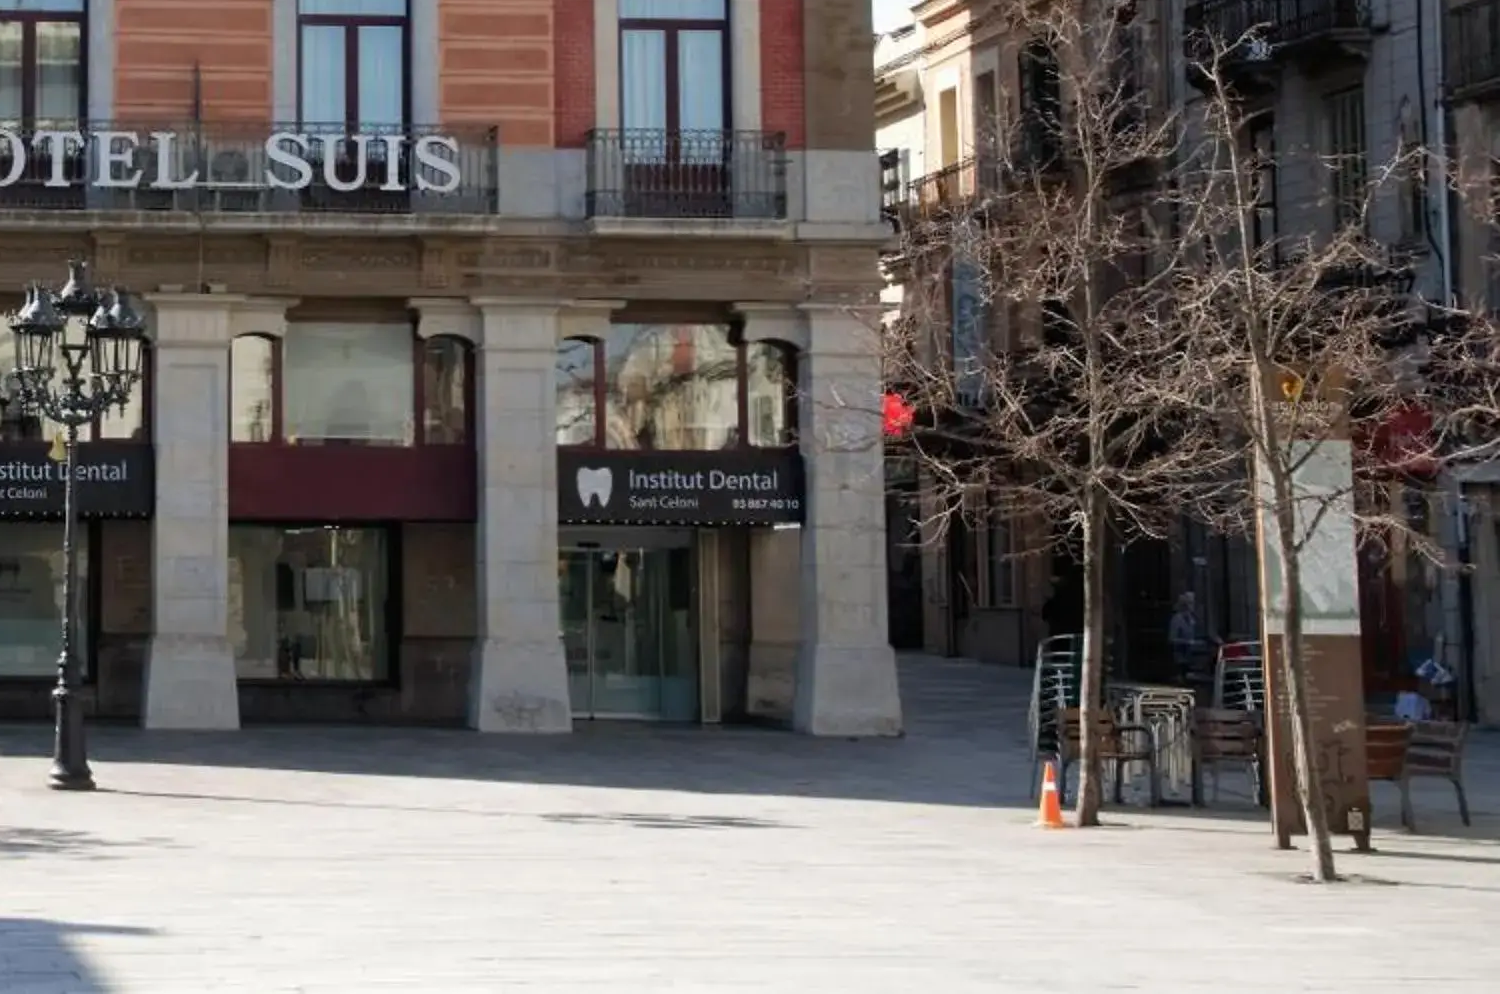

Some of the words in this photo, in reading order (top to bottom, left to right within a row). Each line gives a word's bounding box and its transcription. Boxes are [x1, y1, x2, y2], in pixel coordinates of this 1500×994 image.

[265, 132, 461, 192] SUIS
[629, 469, 704, 490] Institut
[709, 469, 778, 490] Dental
[7, 487, 47, 499] Celoni
[629, 496, 657, 509] Sant
[659, 496, 699, 509] Celoni
[787, 498, 800, 509] 10
